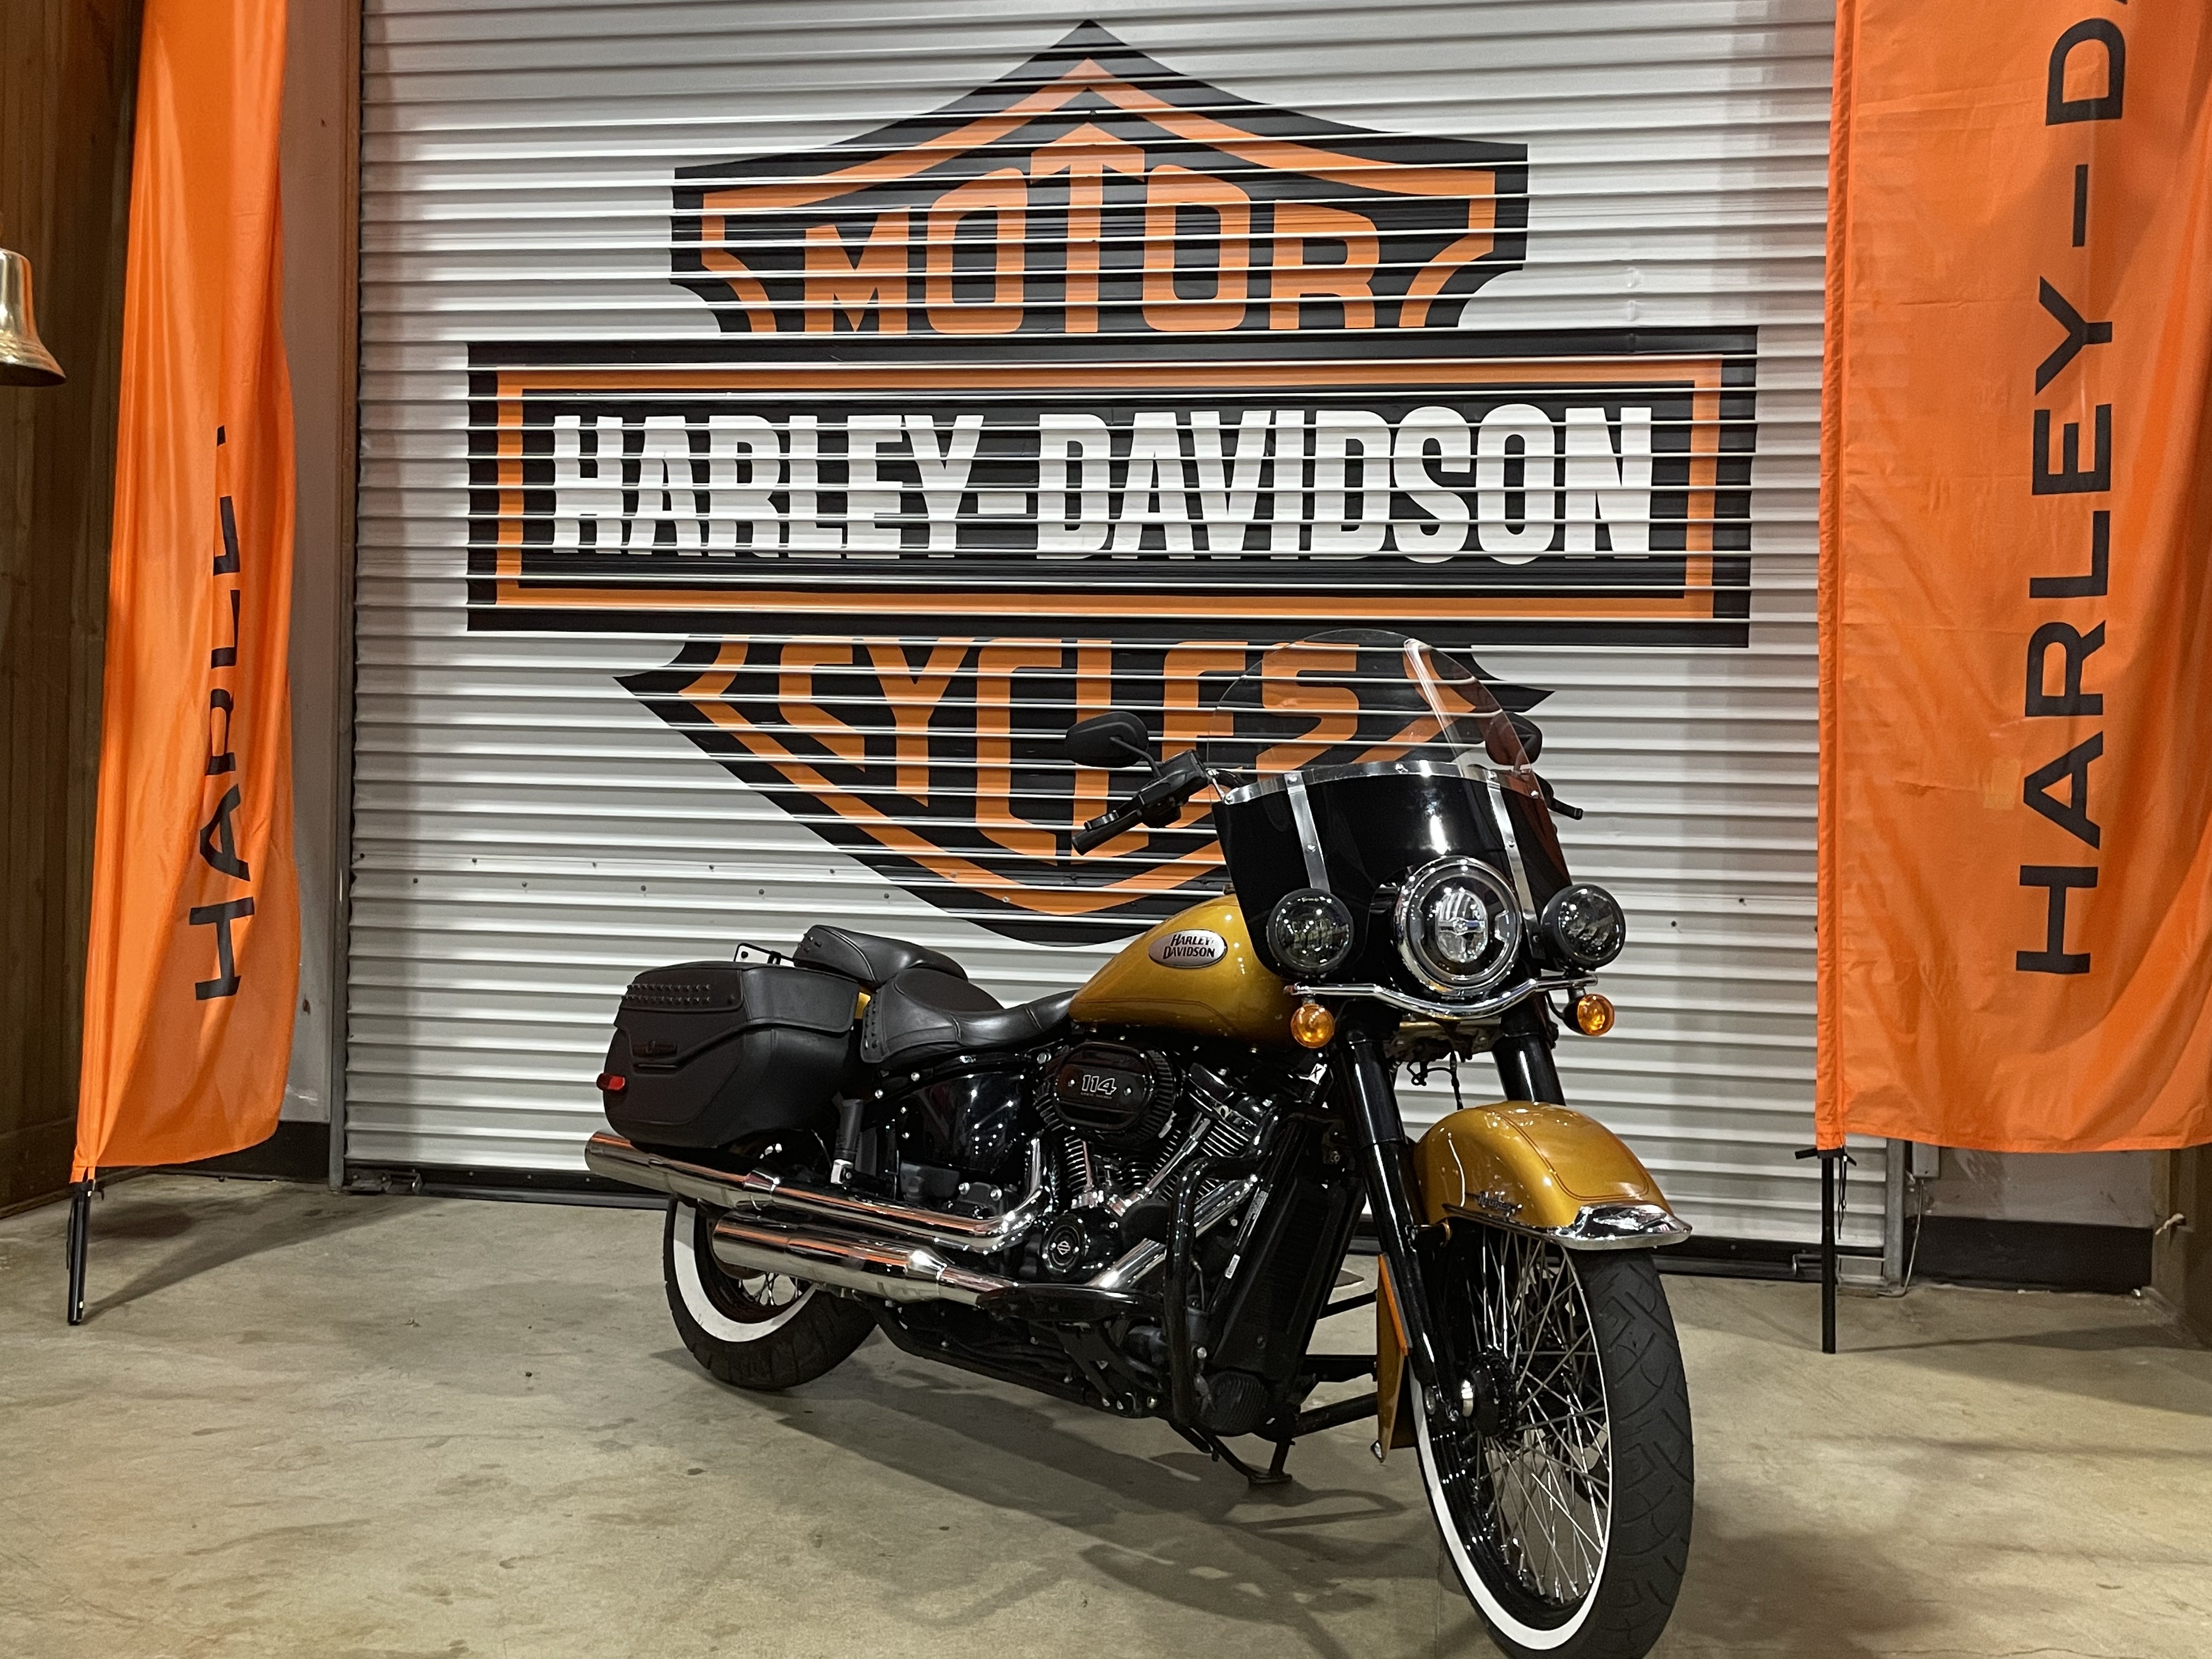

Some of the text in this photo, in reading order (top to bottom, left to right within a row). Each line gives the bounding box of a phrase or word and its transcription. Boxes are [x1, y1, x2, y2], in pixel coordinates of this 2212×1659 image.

[803, 122, 1382, 336] MOTOR
[551, 404, 1653, 565] HARLEY-DAVIDSON
[2016, 0, 2128, 974] HARLEY-D
[778, 635, 1360, 865] CYCLES
[1163, 946, 1215, 960] DAVIDSON
[1081, 1074, 1118, 1095] 114
